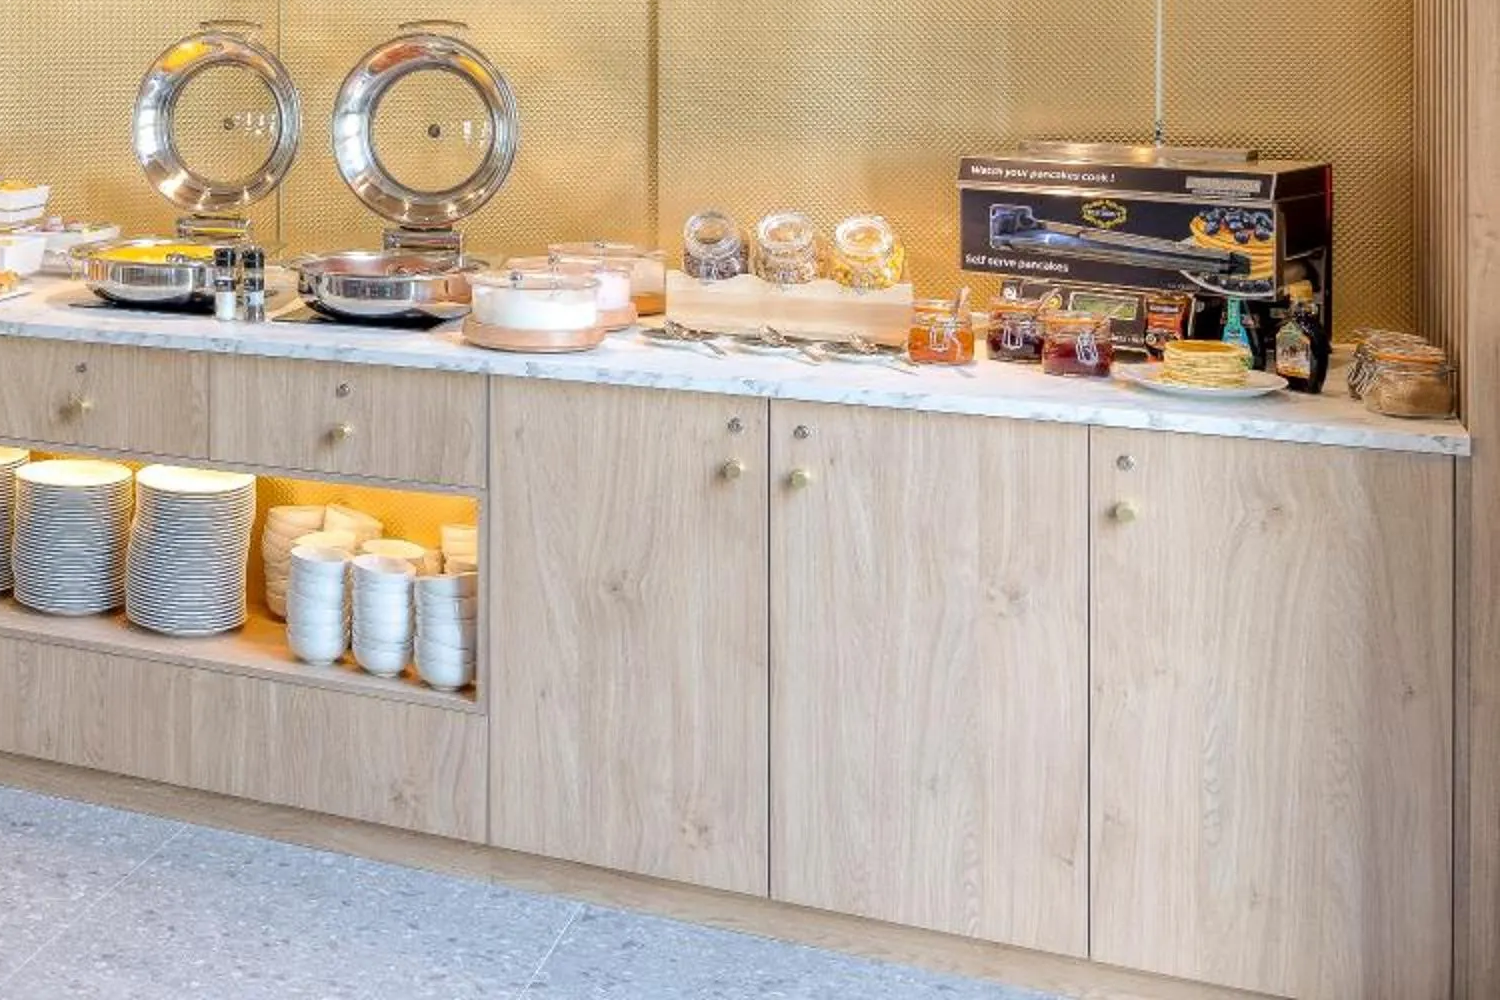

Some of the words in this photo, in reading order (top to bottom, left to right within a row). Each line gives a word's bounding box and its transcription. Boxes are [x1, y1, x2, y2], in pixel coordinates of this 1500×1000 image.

[971, 164, 1002, 175] Watch
[1004, 168, 1028, 178] your
[1029, 170, 1079, 181] pancakes
[965, 253, 986, 264] Self
[987, 258, 1016, 267] serve
[1017, 260, 1069, 272] pancakes
